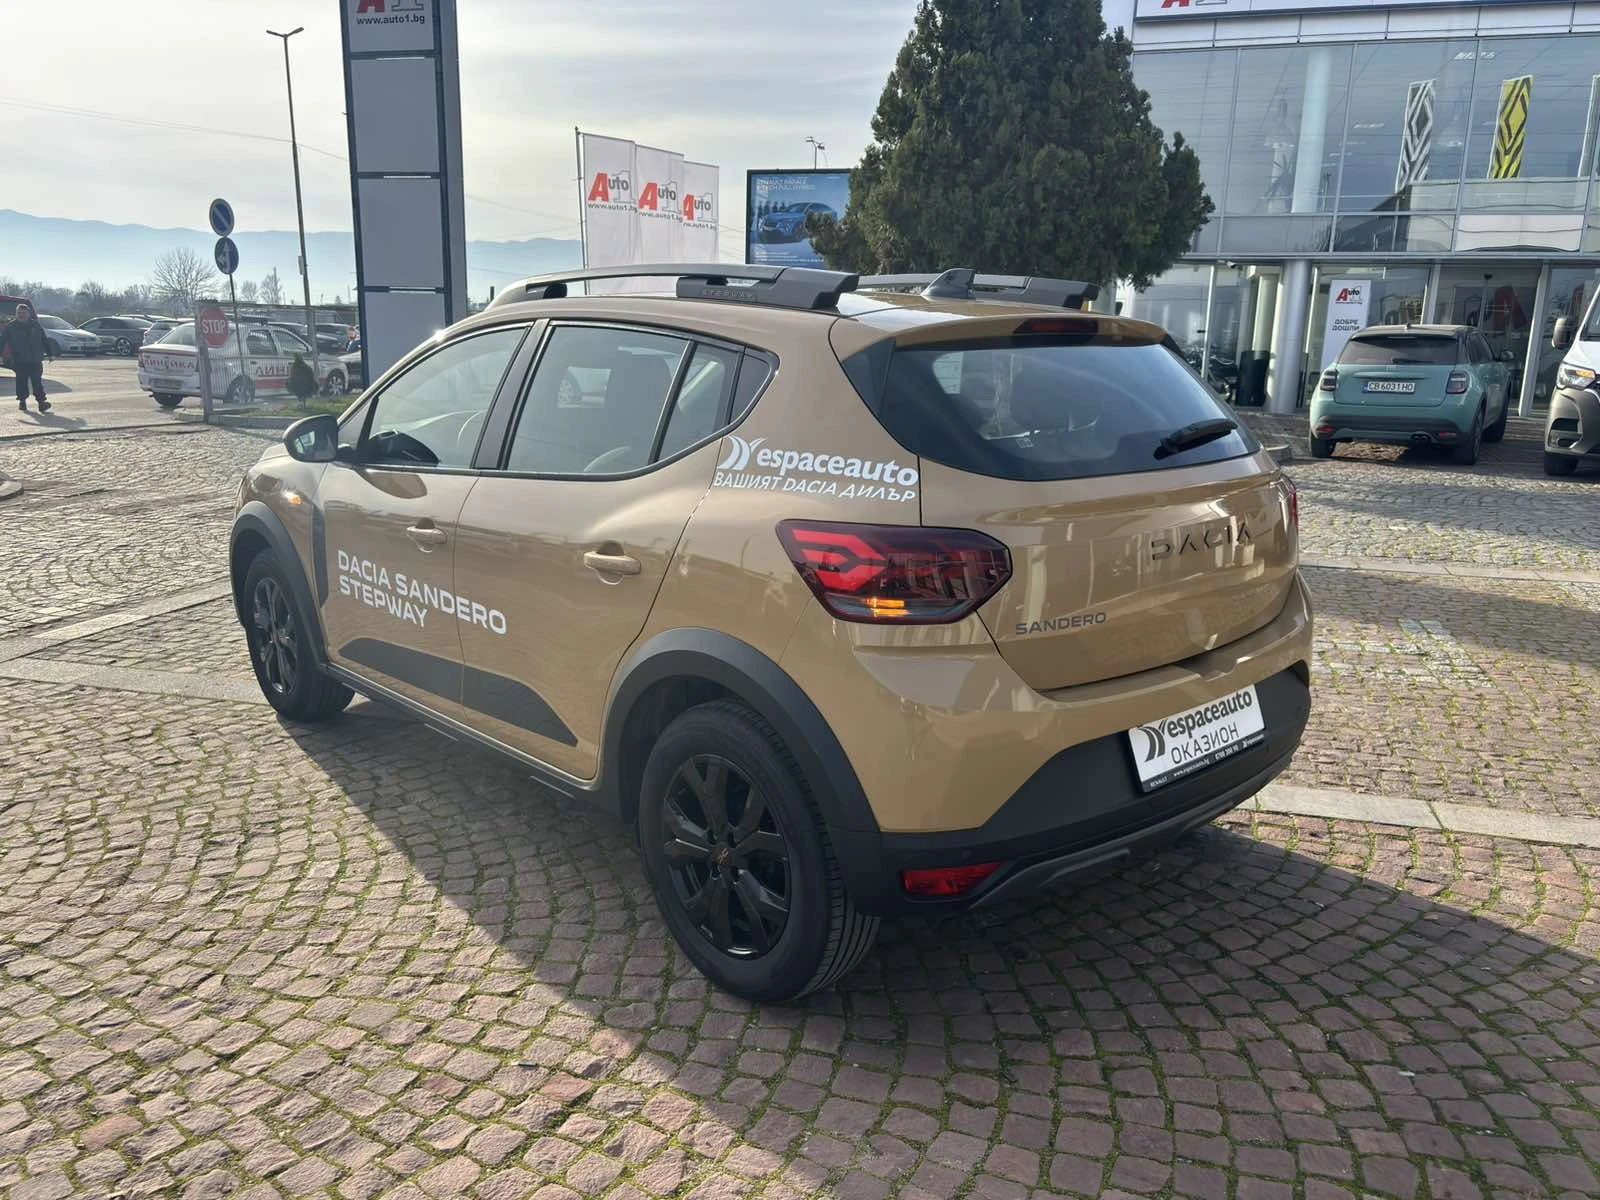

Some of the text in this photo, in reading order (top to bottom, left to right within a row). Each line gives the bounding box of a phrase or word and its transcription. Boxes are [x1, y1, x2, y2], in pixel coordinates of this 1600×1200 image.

[356, 13, 425, 24] www.auto1.bg
[202, 319, 226, 335] STOP
[714, 471, 916, 503] ВАШИЯТ DACIA ДИЛЪР
[756, 448, 919, 487] espaceauto
[338, 549, 507, 635] DACIA SANDERO
[339, 574, 428, 628] STEPWAY
[1015, 612, 1107, 636] SANDERO
[1167, 690, 1253, 739] espaceauto
[1170, 721, 1240, 765] ОКАЗИОН
